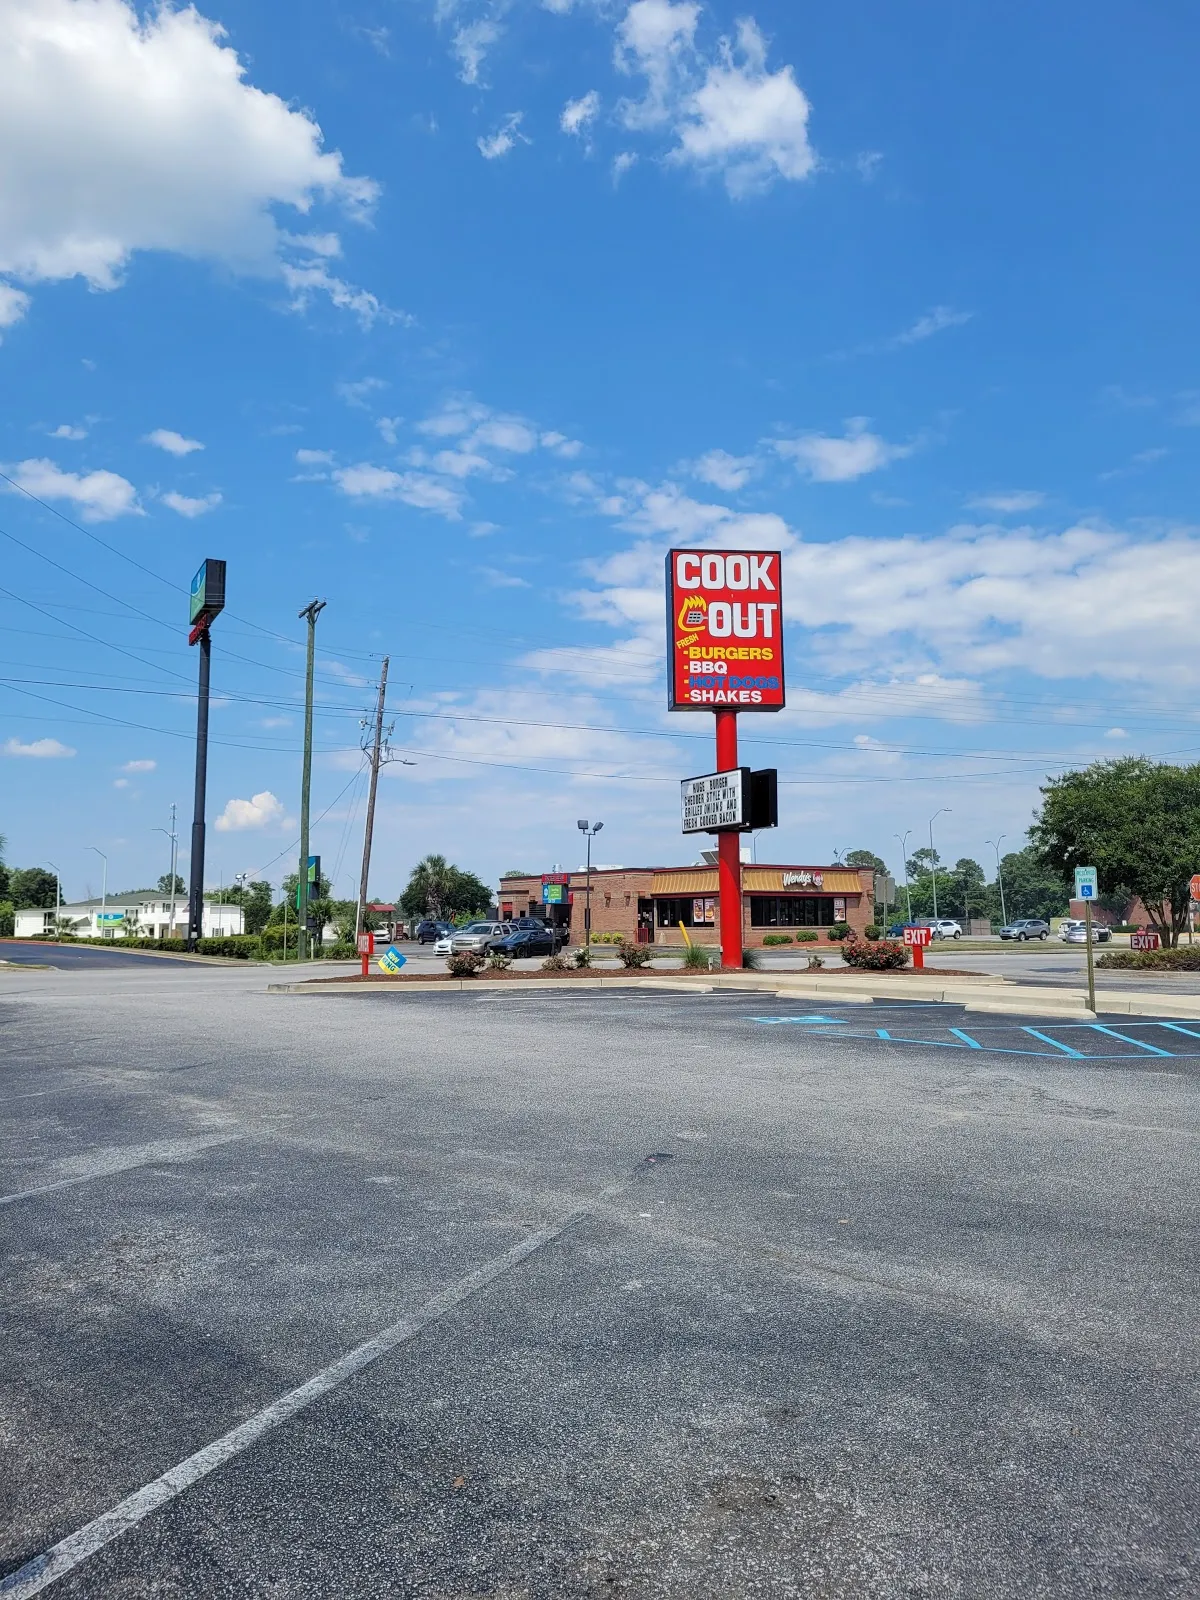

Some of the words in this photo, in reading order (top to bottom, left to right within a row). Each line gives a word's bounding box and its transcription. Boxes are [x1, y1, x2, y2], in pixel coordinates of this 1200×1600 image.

[677, 554, 775, 590] COOK
[709, 602, 777, 637] OUT
[676, 633, 698, 648] FRESH
[689, 647, 773, 660] BURGERS
[689, 661, 727, 673] BBQ
[689, 676, 725, 688] HOT
[729, 677, 779, 689] DOGS
[690, 690, 762, 702] SHAKES
[693, 782, 705, 793] HUGE
[710, 777, 727, 789] BURGER
[685, 795, 704, 806] CHEDDER
[707, 790, 720, 802] STYLE
[723, 787, 735, 799] WITH
[685, 805, 702, 817] GRILLED
[704, 801, 722, 814] ONIONS
[727, 799, 737, 810] AND
[684, 817, 697, 829] FRESH
[700, 815, 717, 826] COOKED
[720, 811, 736, 823] BACON
[783, 870, 812, 887] Wendy's
[904, 929, 927, 944] EXIT
[1132, 936, 1155, 948] EXIT
